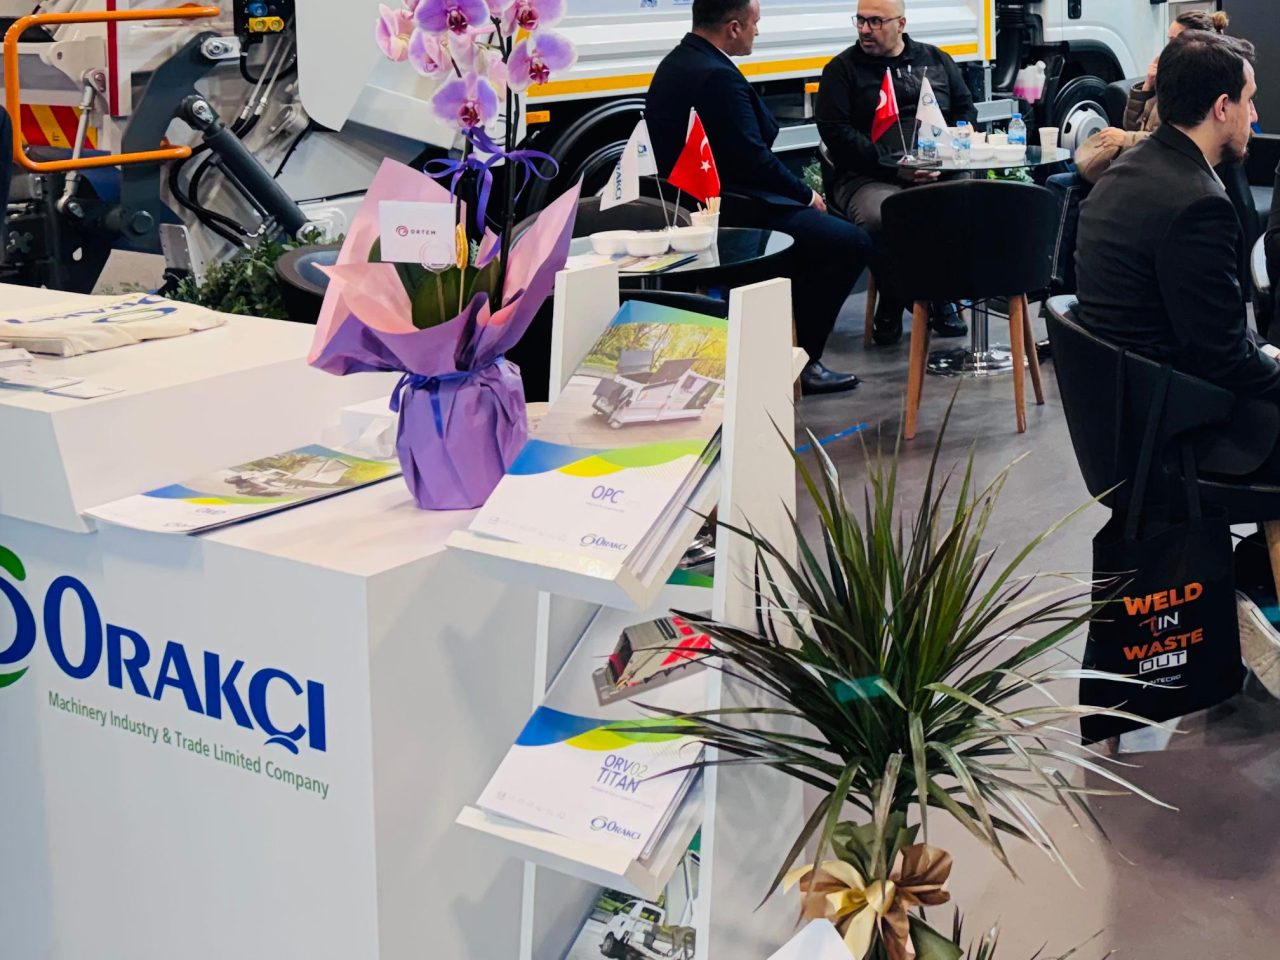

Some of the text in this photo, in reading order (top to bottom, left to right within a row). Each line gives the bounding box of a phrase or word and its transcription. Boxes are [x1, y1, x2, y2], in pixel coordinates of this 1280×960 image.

[591, 485, 625, 504] OPC
[1123, 582, 1203, 616] WELD
[1123, 628, 1204, 661] WASTE
[43, 575, 327, 755] ORAKÇI
[1141, 651, 1185, 673] OUT
[48, 690, 330, 800] Machinery Industry & Trade Limited Company
[597, 767, 640, 794] TITAN
